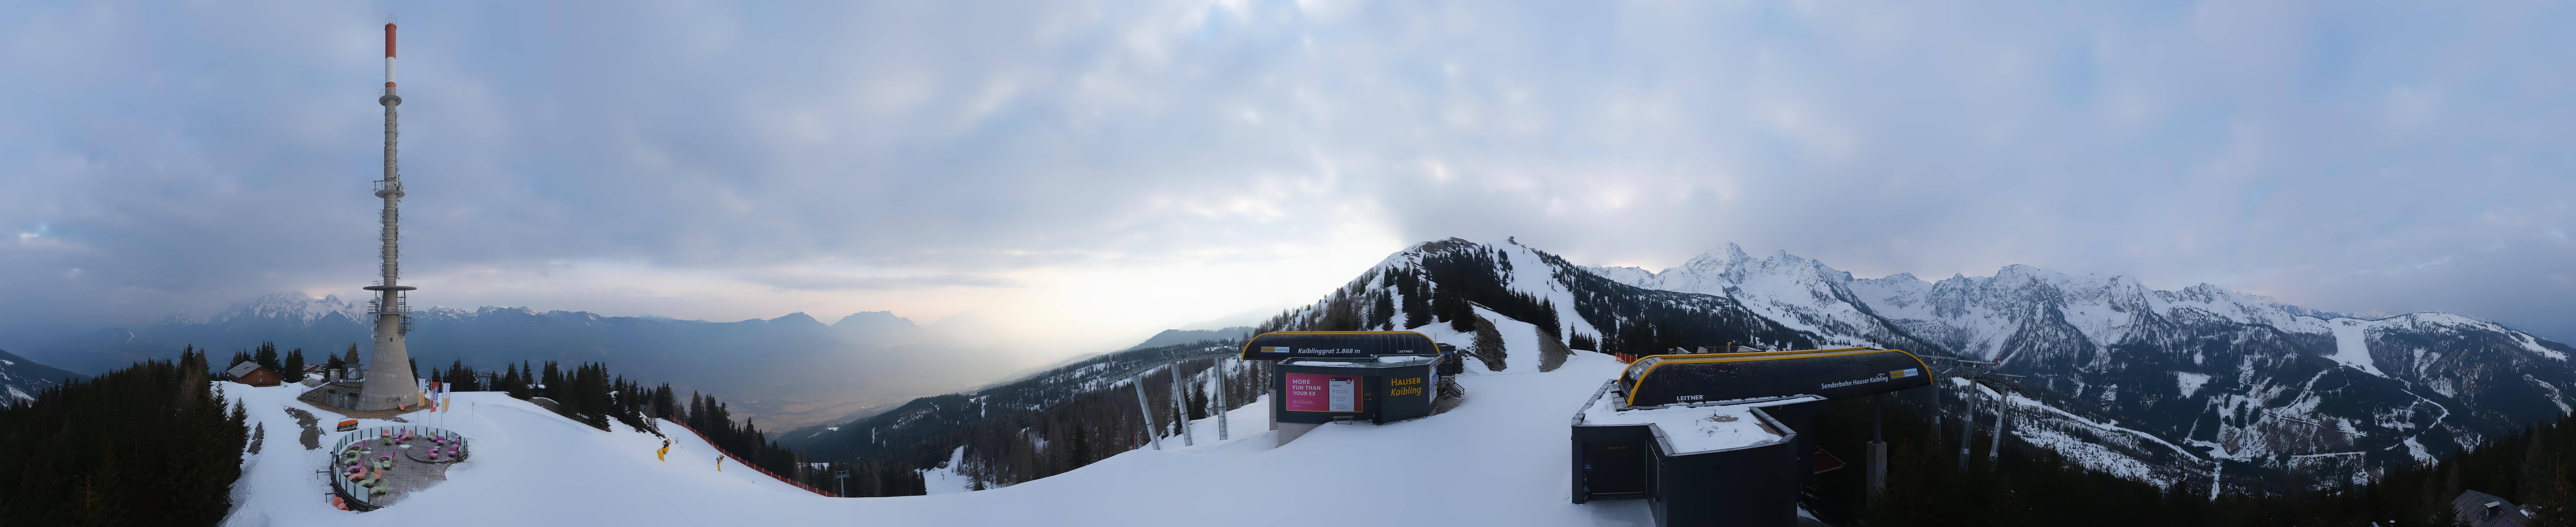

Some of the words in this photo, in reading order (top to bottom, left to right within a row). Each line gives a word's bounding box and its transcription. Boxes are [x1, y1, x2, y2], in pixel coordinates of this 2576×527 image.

[1391, 378, 1421, 386] HAUSER
[1821, 380, 1852, 389] Senderbahn
[1391, 386, 1421, 396] Kaibling
